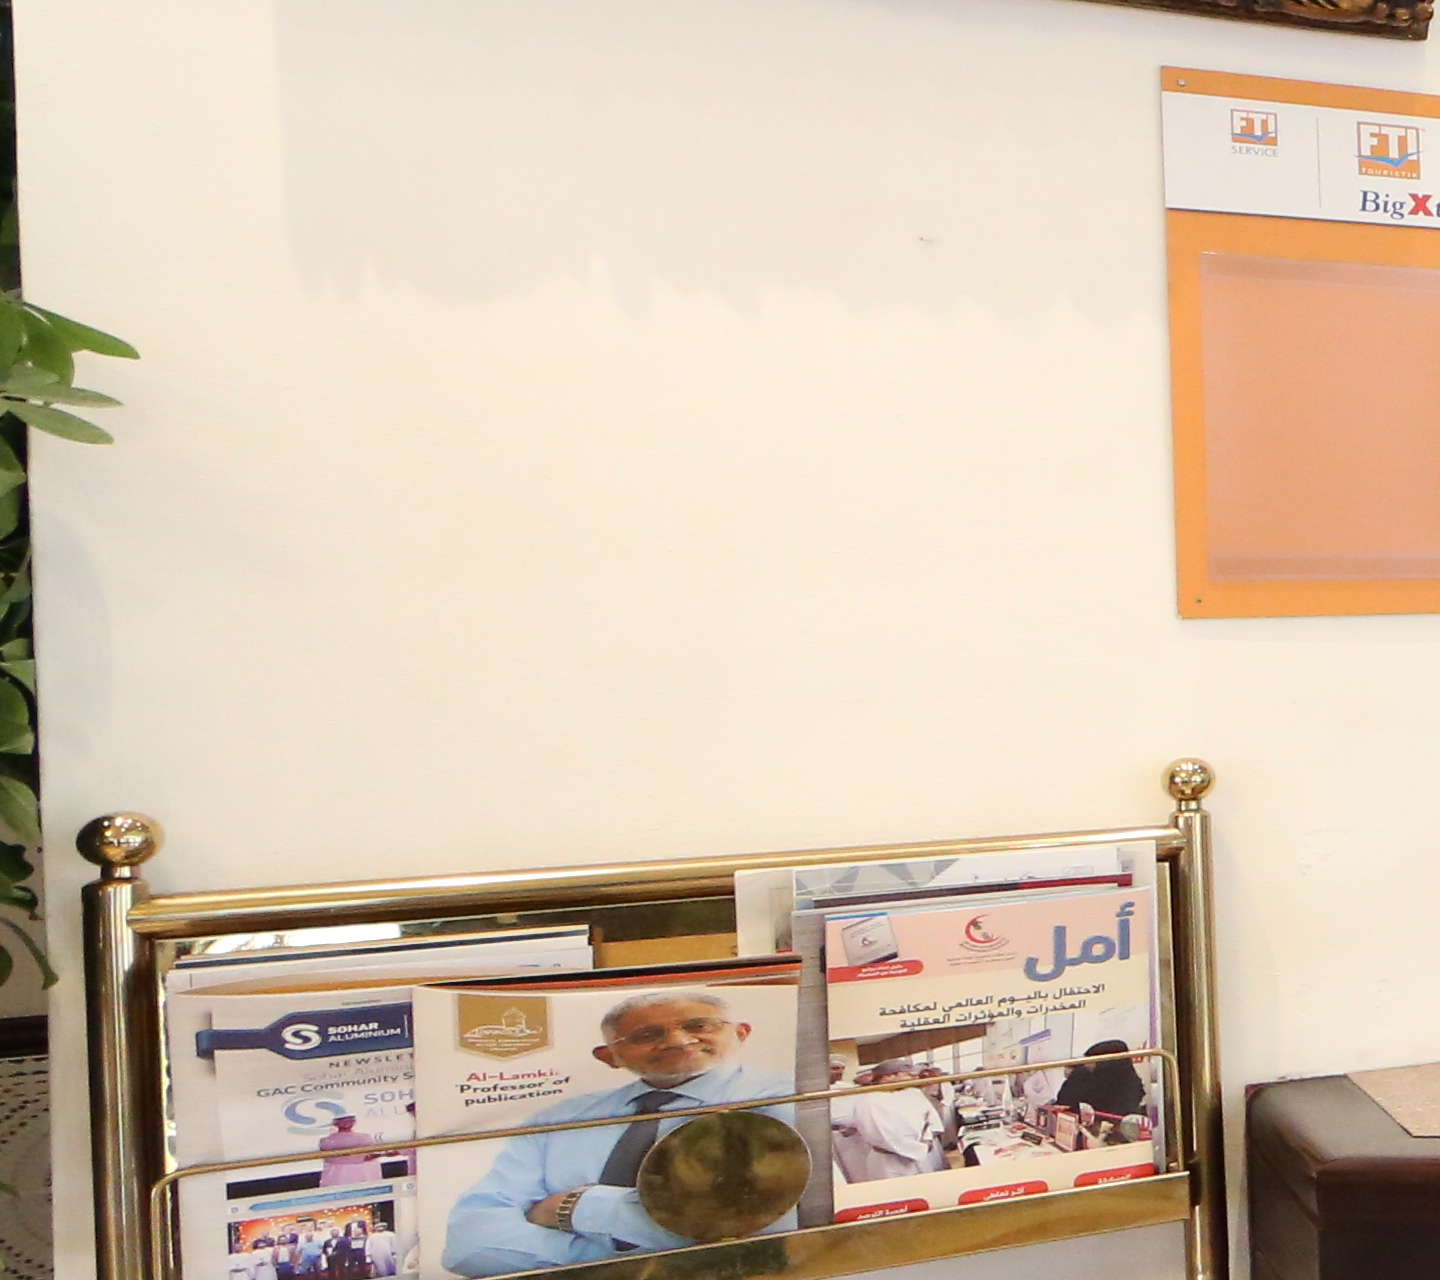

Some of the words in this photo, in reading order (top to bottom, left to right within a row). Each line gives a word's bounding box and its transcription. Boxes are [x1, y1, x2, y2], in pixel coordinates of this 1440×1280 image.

[1233, 111, 1276, 137] FTI
[1231, 145, 1279, 158] SERVICE
[1358, 124, 1419, 161] FTI
[1361, 166, 1419, 178] TOURISTIK
[1022, 901, 1135, 983] أمل
[327, 1021, 381, 1035] SOHAR
[328, 1028, 403, 1044] ALUMINIUM
[257, 1086, 296, 1097] GAC
[301, 1075, 398, 1092] Community
[552, 1076, 571, 1086] of
[464, 1087, 563, 1107] publication
